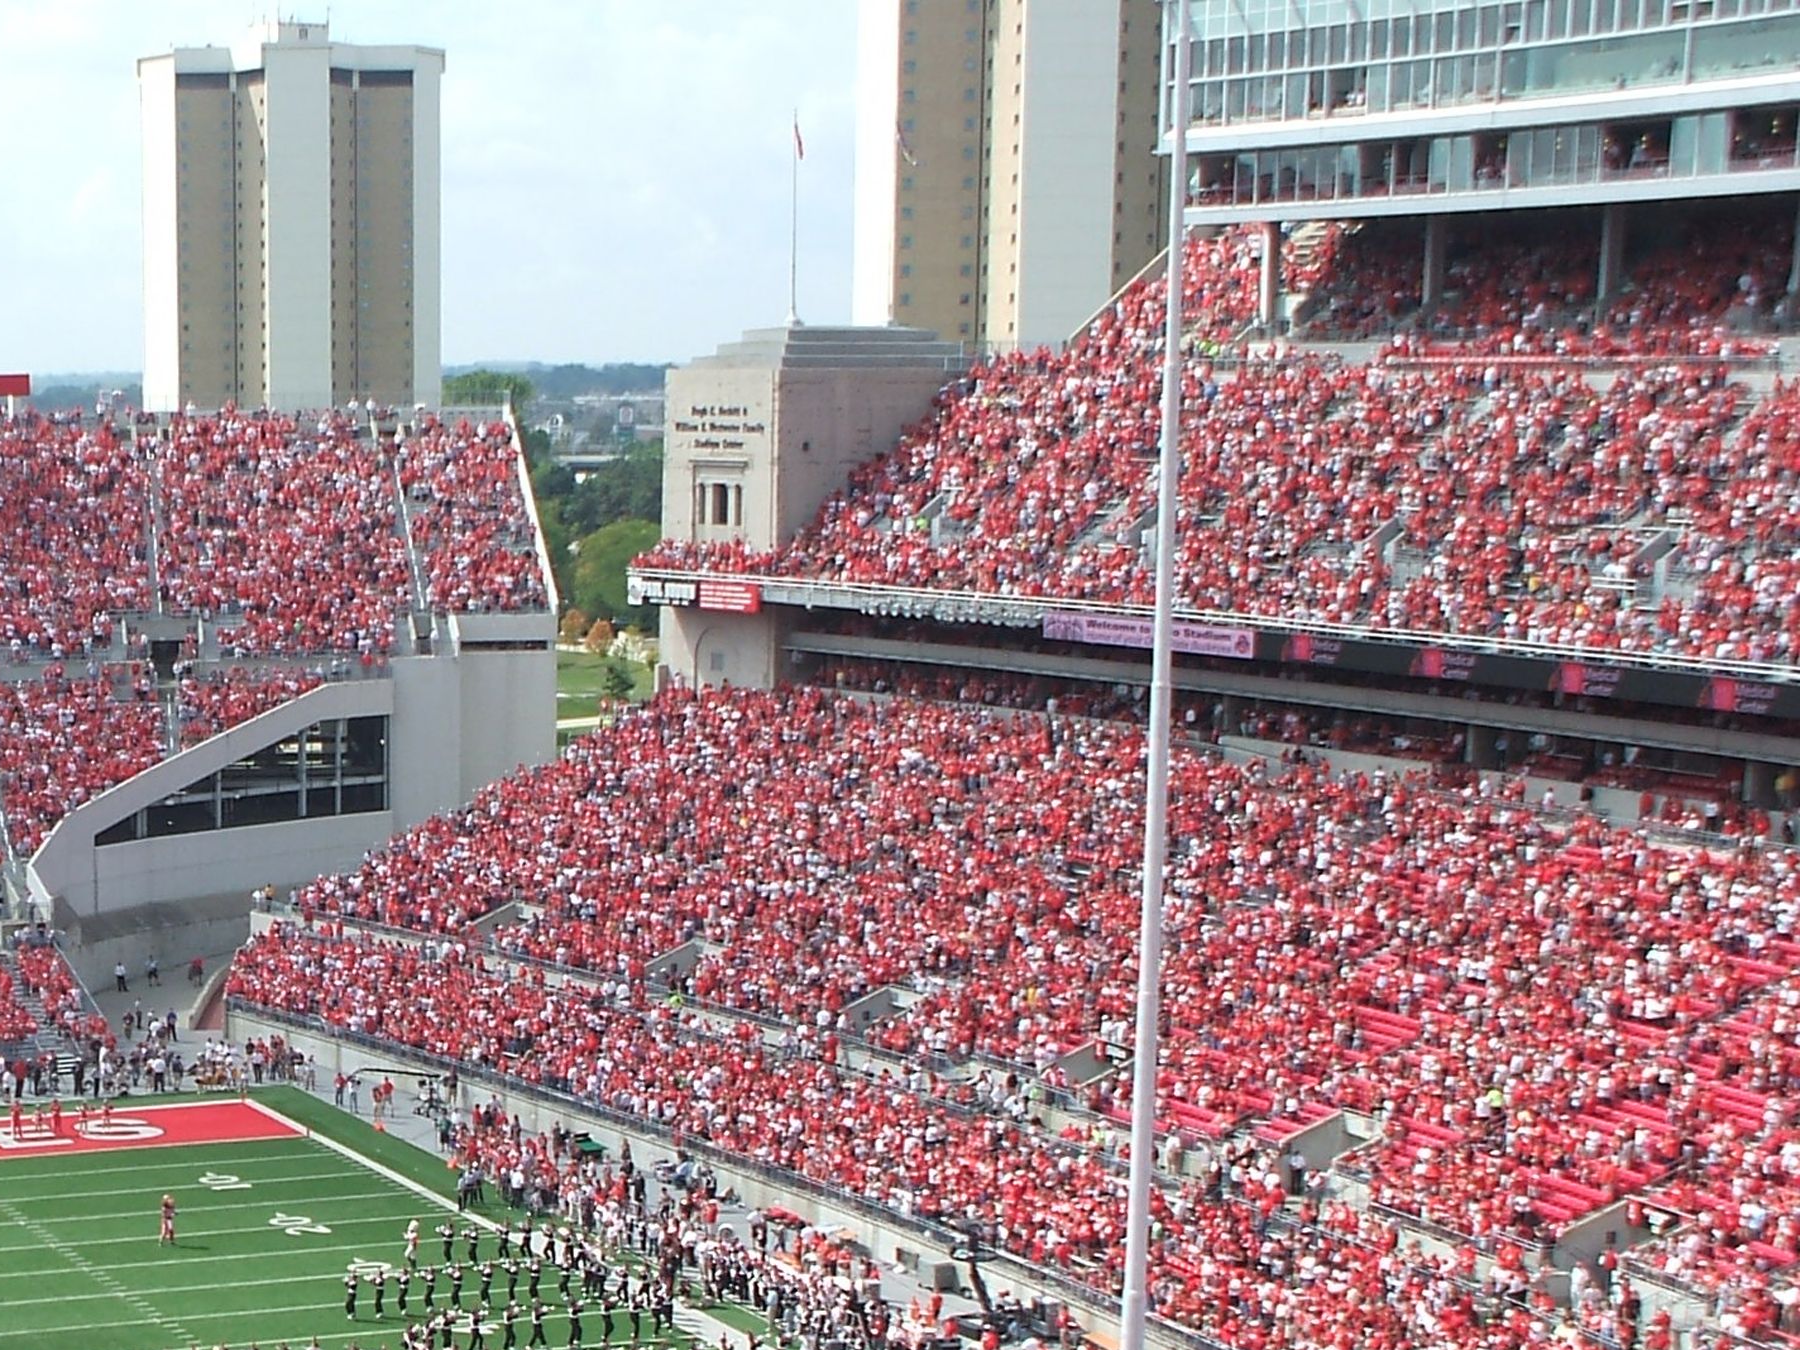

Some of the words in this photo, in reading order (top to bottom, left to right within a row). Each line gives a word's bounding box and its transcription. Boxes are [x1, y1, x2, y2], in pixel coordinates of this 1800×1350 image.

[1085, 619, 1137, 632] Welcome
[1139, 624, 1152, 634] to
[1183, 628, 1232, 642] Stadium
